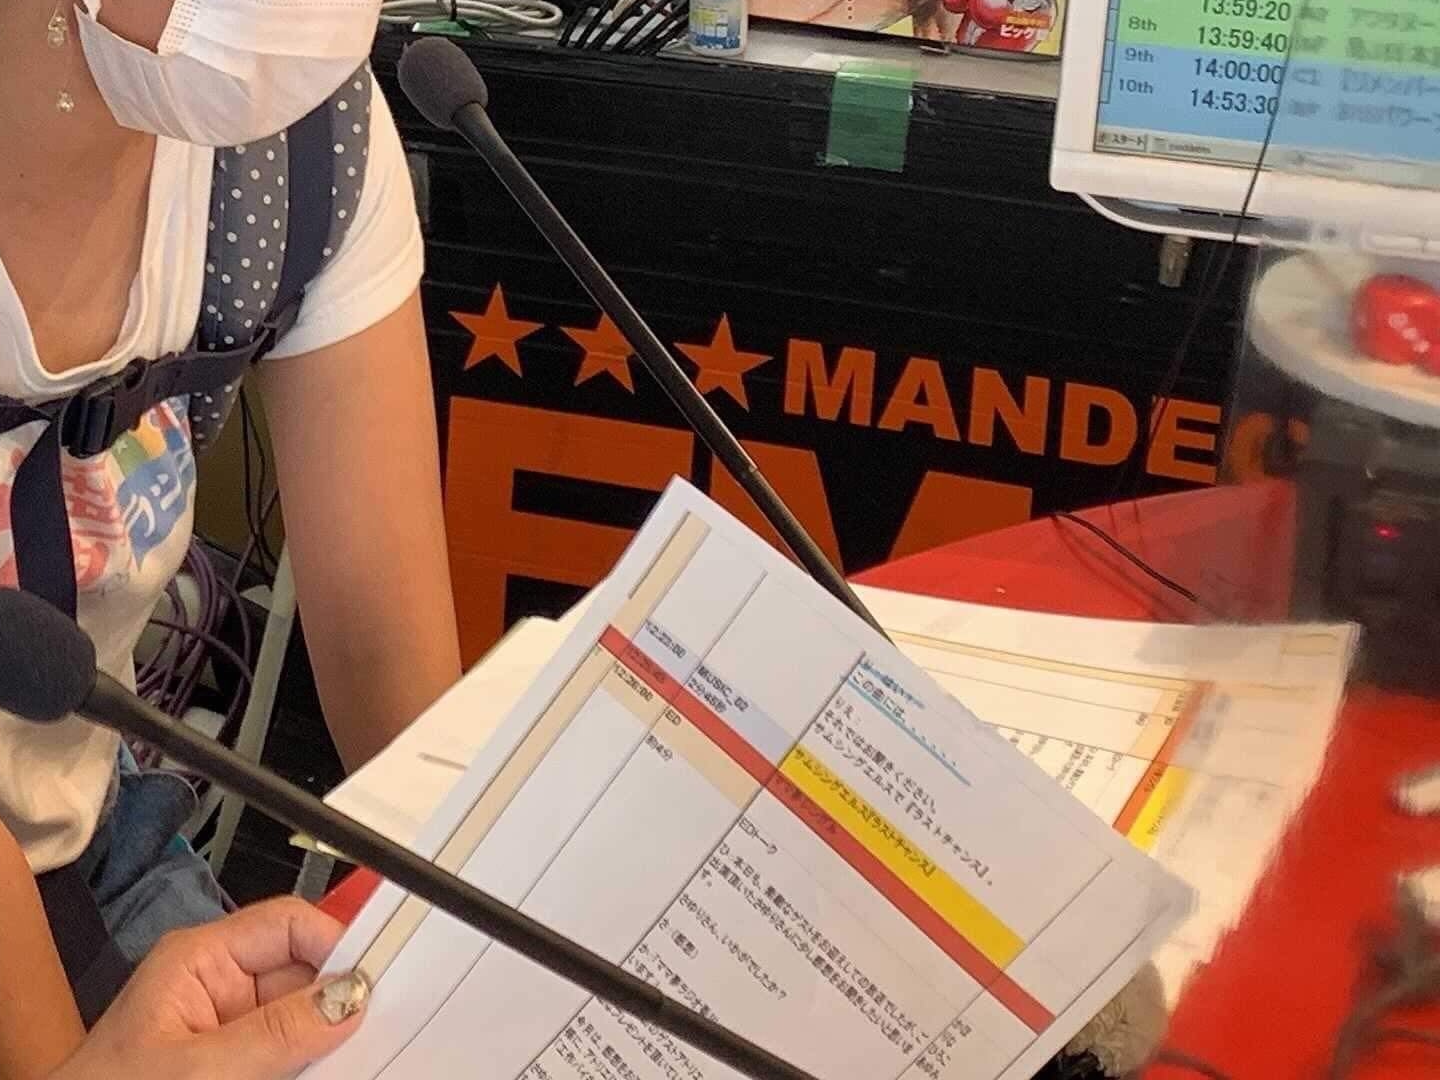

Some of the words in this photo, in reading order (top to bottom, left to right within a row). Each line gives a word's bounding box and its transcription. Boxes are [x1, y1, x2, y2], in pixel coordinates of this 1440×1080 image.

[1128, 17, 1158, 32] 8th
[1197, 26, 1288, 53] 13:59:40
[1124, 48, 1154, 64] 9th
[1193, 58, 1284, 85] 14:00:00
[1118, 79, 1154, 95] 10th
[1190, 88, 1280, 115] 14:53:30
